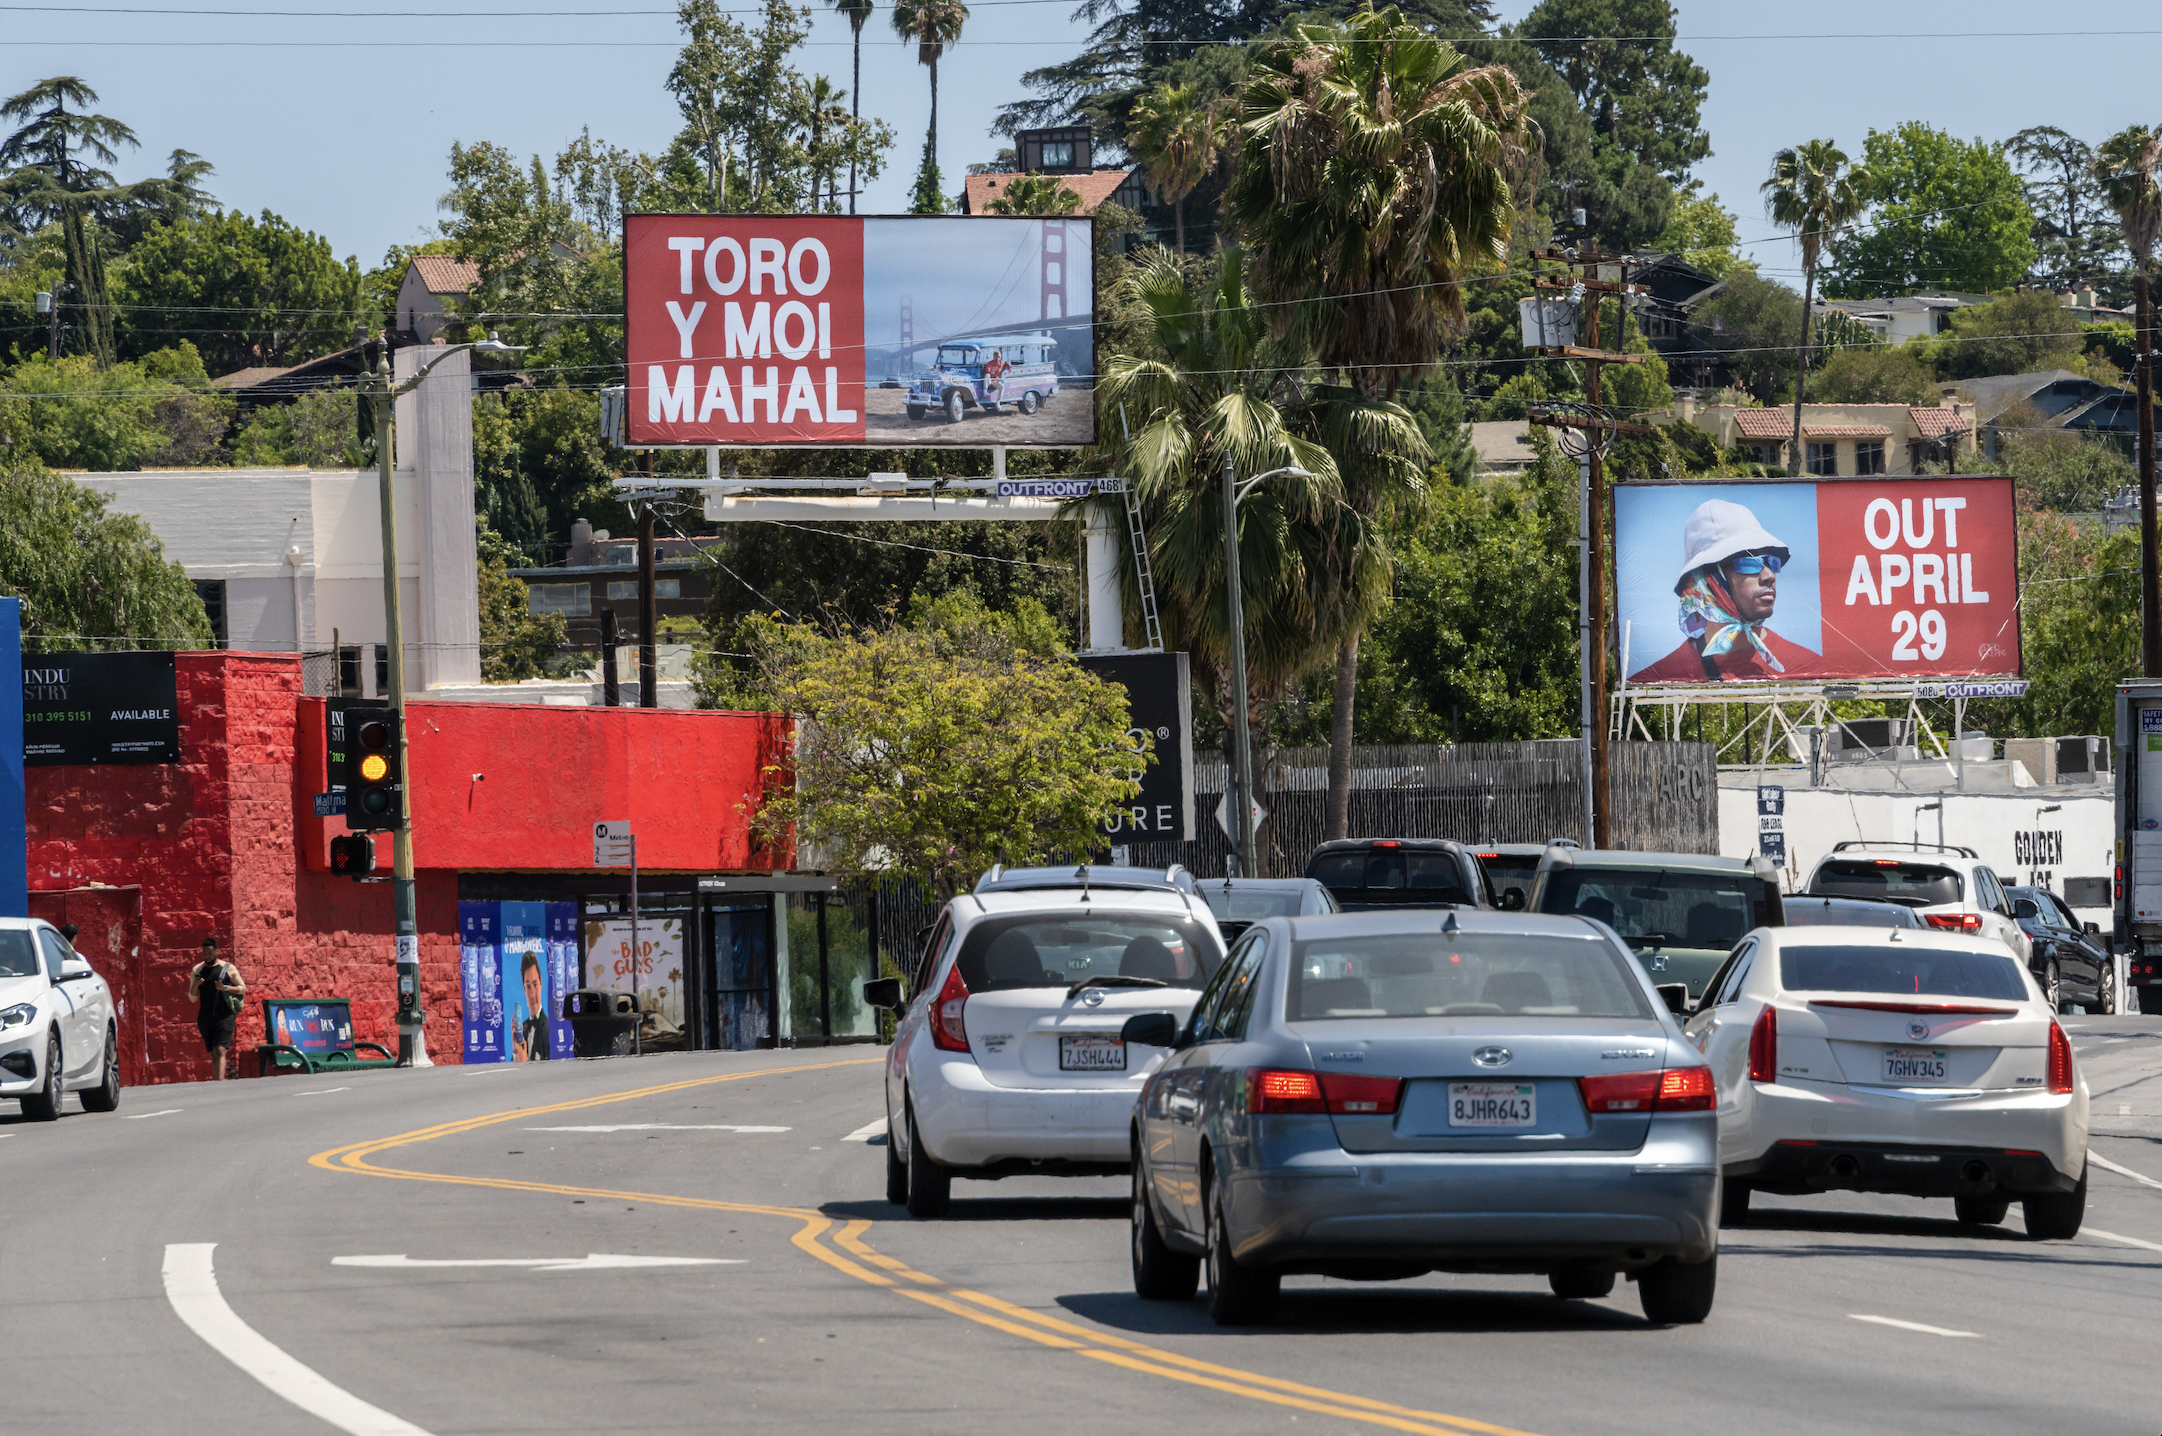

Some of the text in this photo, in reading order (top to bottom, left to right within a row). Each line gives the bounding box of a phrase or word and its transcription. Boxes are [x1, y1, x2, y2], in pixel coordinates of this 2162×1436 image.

[668, 236, 831, 296] TORO
[665, 300, 831, 361] Y MOI
[648, 365, 858, 423] MAHAL
[999, 481, 1089, 496] OUTFRONT
[1864, 497, 1966, 550] OUT
[1845, 553, 1990, 606] APRIL
[1891, 609, 1947, 661] 29
[23, 668, 71, 684] INDU
[24, 684, 71, 701] STRY
[1947, 682, 2024, 697] OUTFRONT
[25, 711, 92, 722] 310 395 5151
[110, 708, 170, 721] AVAILABLE
[331, 710, 345, 727] IN
[2143, 710, 2162, 718] SAFET
[332, 727, 345, 742] ST
[315, 794, 347, 807] Maltma
[595, 846, 600, 855] 2
[2014, 830, 2063, 866] GOLDEN
[594, 856, 600, 864] 4
[613, 957, 654, 976] GUYS
[1067, 960, 1088, 970] KIA
[1064, 1050, 1121, 1065] 7JSH444
[1895, 1051, 1934, 1060] California
[1886, 1060, 1945, 1078] 7GHV345
[1466, 1085, 1518, 1099] California
[1454, 1099, 1531, 1120] 8JHR643
